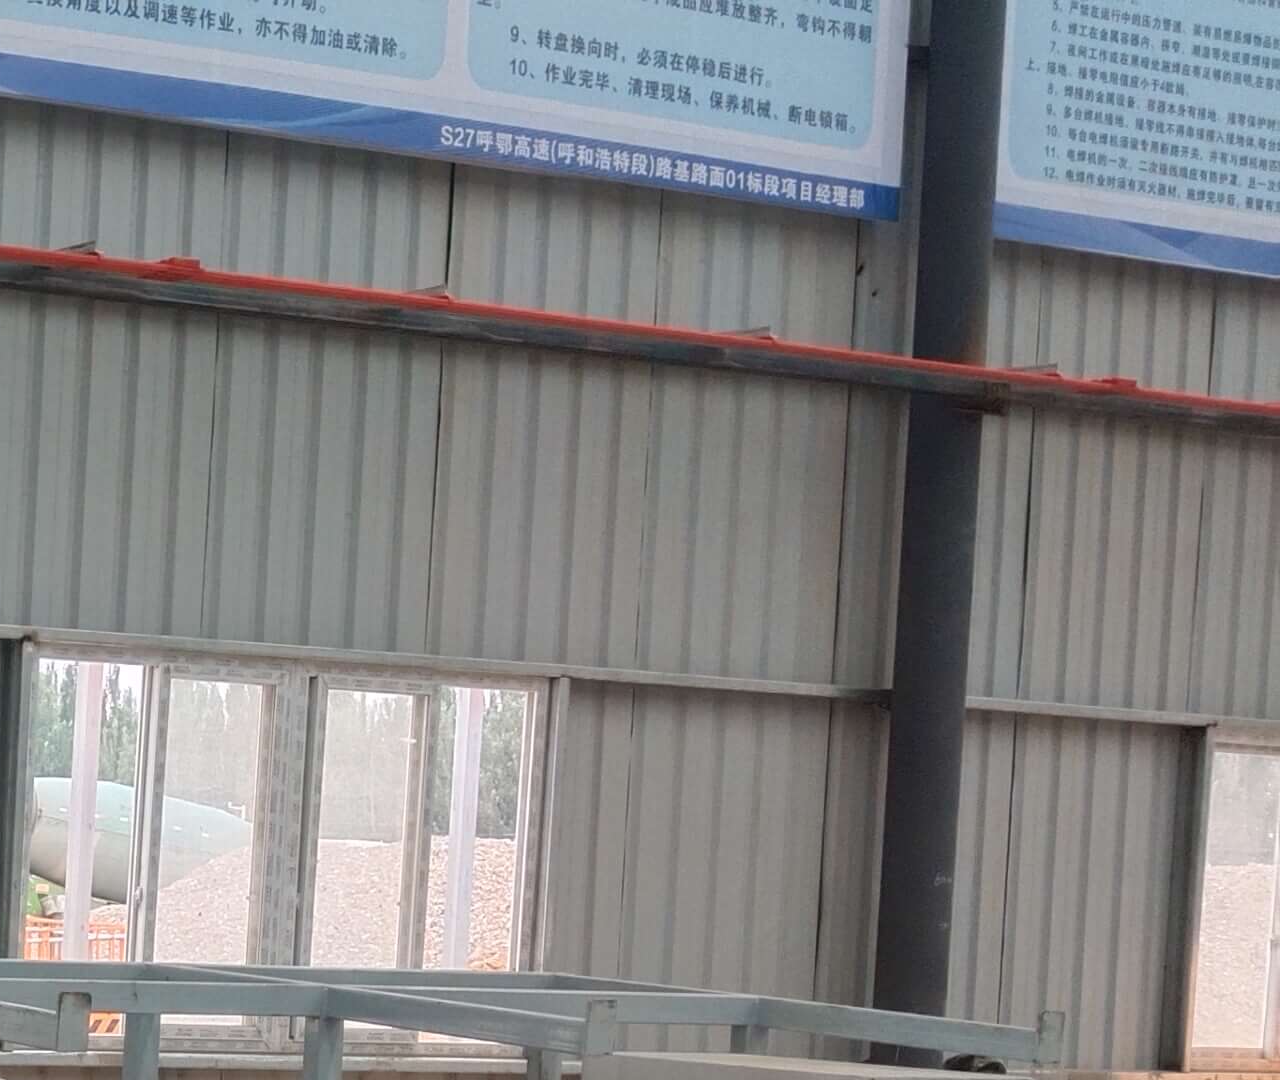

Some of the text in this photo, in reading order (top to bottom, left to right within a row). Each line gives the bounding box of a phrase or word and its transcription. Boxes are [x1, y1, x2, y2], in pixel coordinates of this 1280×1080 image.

[26, 0, 406, 60] 角度以及调速等作业，亦不得加油或清除。
[440, 125, 866, 209] S27呼鄂高速(呼和浩特段)路基路面01标段项目经理部
